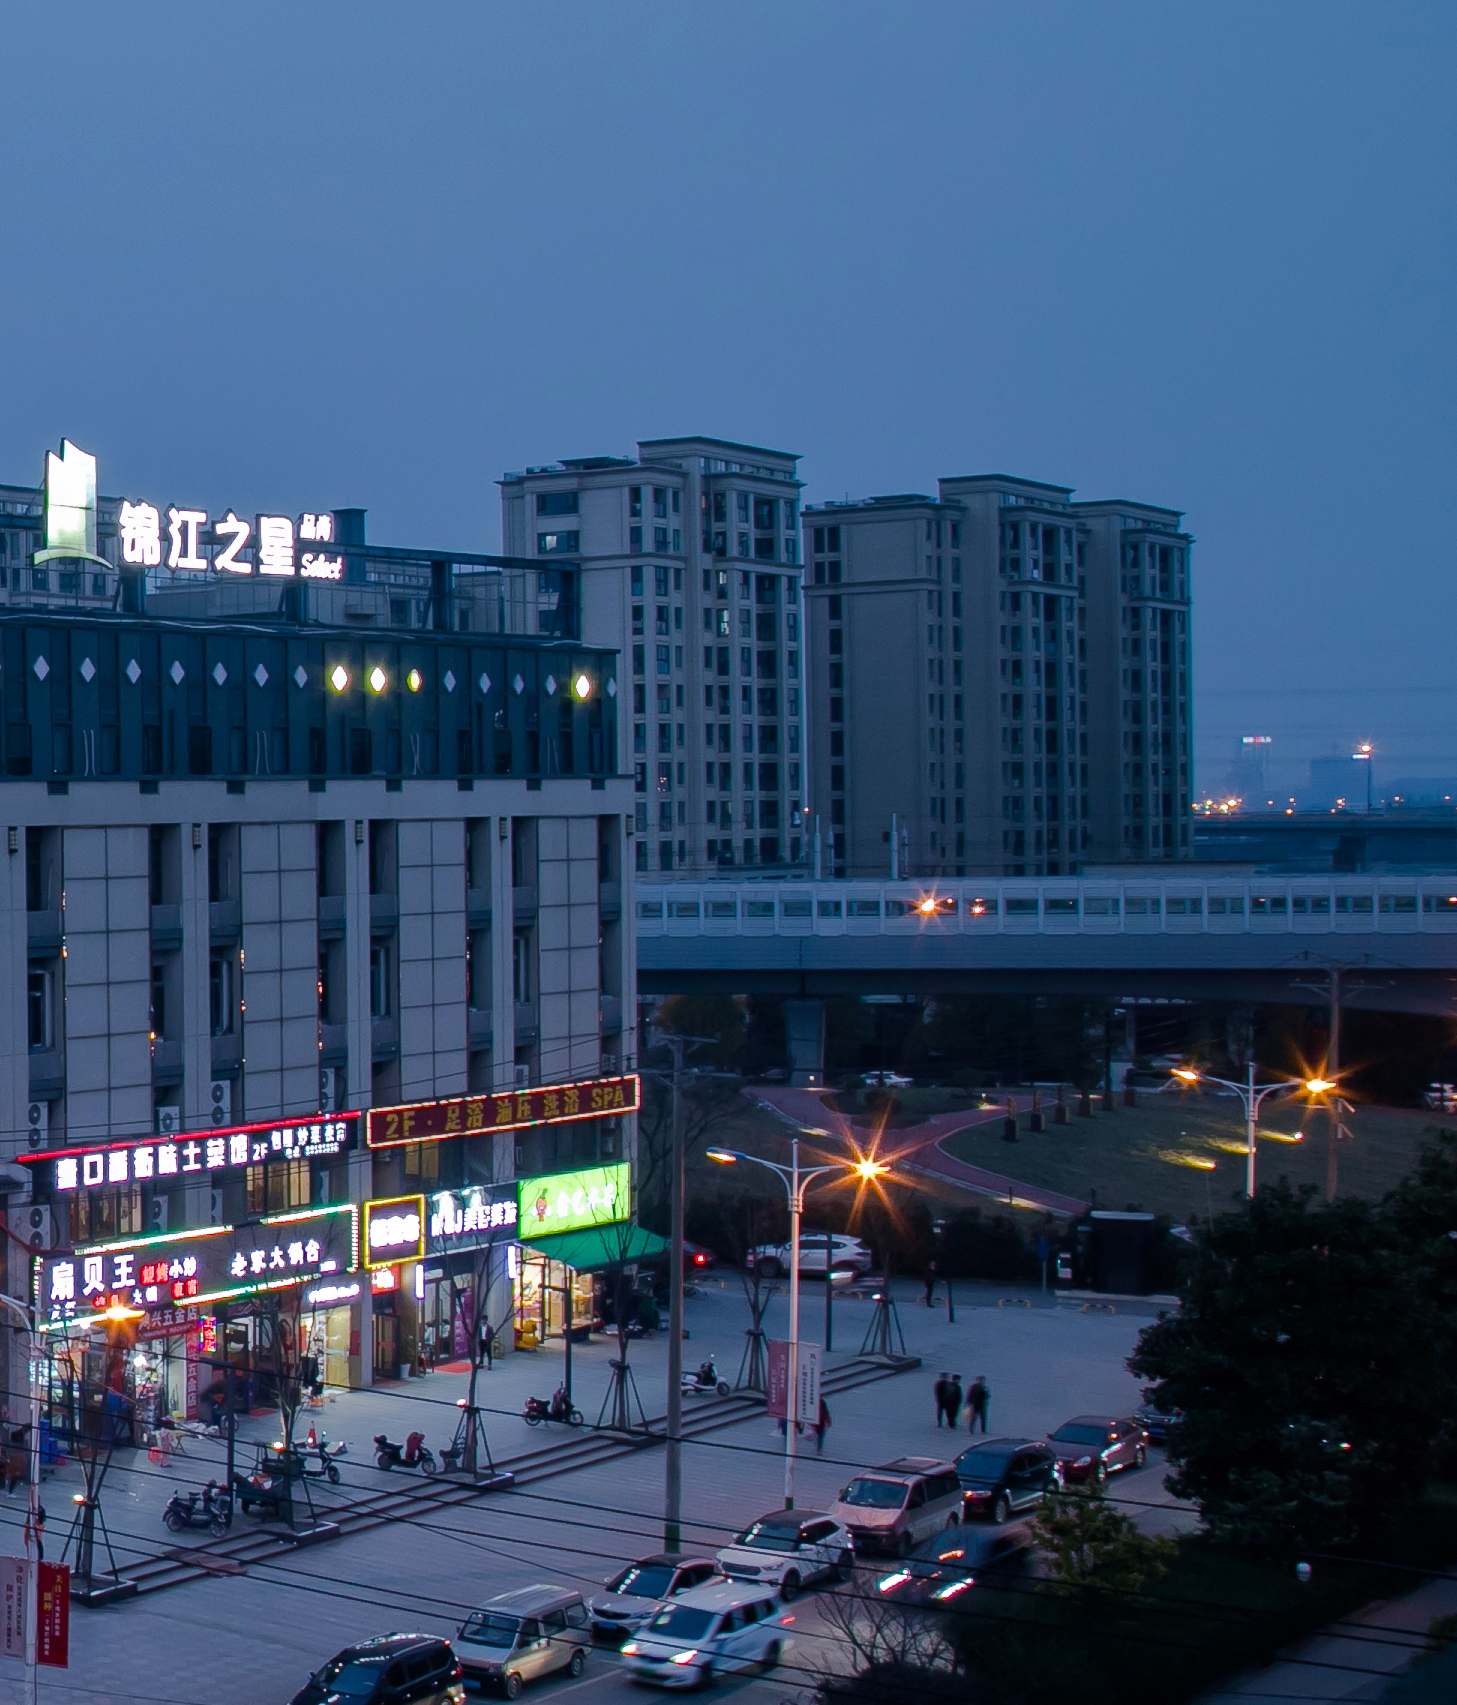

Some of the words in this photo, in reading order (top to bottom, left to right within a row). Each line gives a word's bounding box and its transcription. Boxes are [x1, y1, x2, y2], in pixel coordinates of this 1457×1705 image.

[119, 501, 295, 576] 锦江之星
[300, 554, 343, 580] Select
[590, 1084, 625, 1109] SPA
[252, 1142, 269, 1162] 2F
